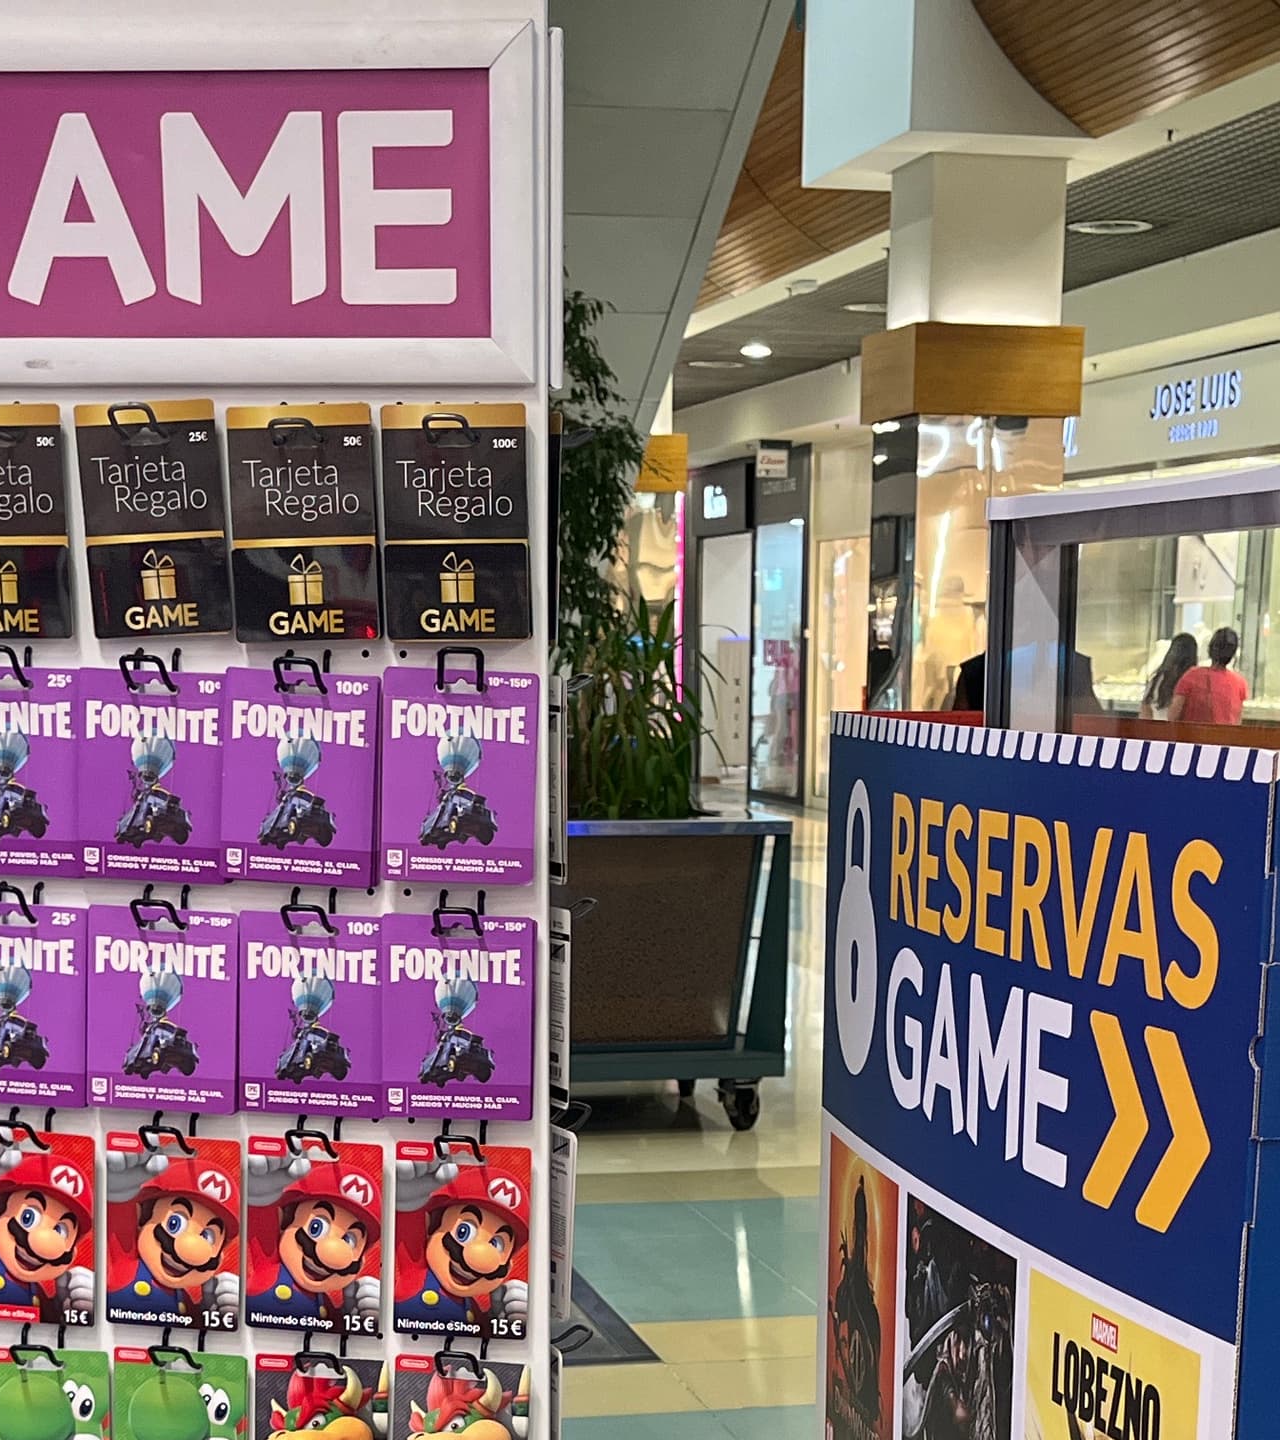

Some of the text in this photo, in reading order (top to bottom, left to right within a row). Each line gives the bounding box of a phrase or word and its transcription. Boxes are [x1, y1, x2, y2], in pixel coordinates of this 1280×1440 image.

[1150, 369, 1242, 420] JOSE LUIS
[36, 437, 55, 447] 50€
[189, 432, 208, 441] 25€
[344, 436, 362, 446] 50€
[492, 438, 517, 448] 100€
[91, 456, 185, 490] Tarjeta
[242, 460, 338, 493] Tarjeta
[396, 460, 492, 493] Tarjeta
[116, 484, 207, 518] Regalo
[266, 488, 359, 521] Regalo
[418, 489, 512, 522] Regalo
[125, 604, 199, 630] GAME
[269, 610, 344, 634] GAME
[86, 700, 219, 745] FORTNITE
[232, 700, 366, 747] FORTNITE
[391, 700, 526, 745] FORTNITE
[889, 792, 1222, 1009] RESERVAS
[885, 947, 1072, 1188] GAME
[1092, 1315, 1118, 1350] MARVEL
